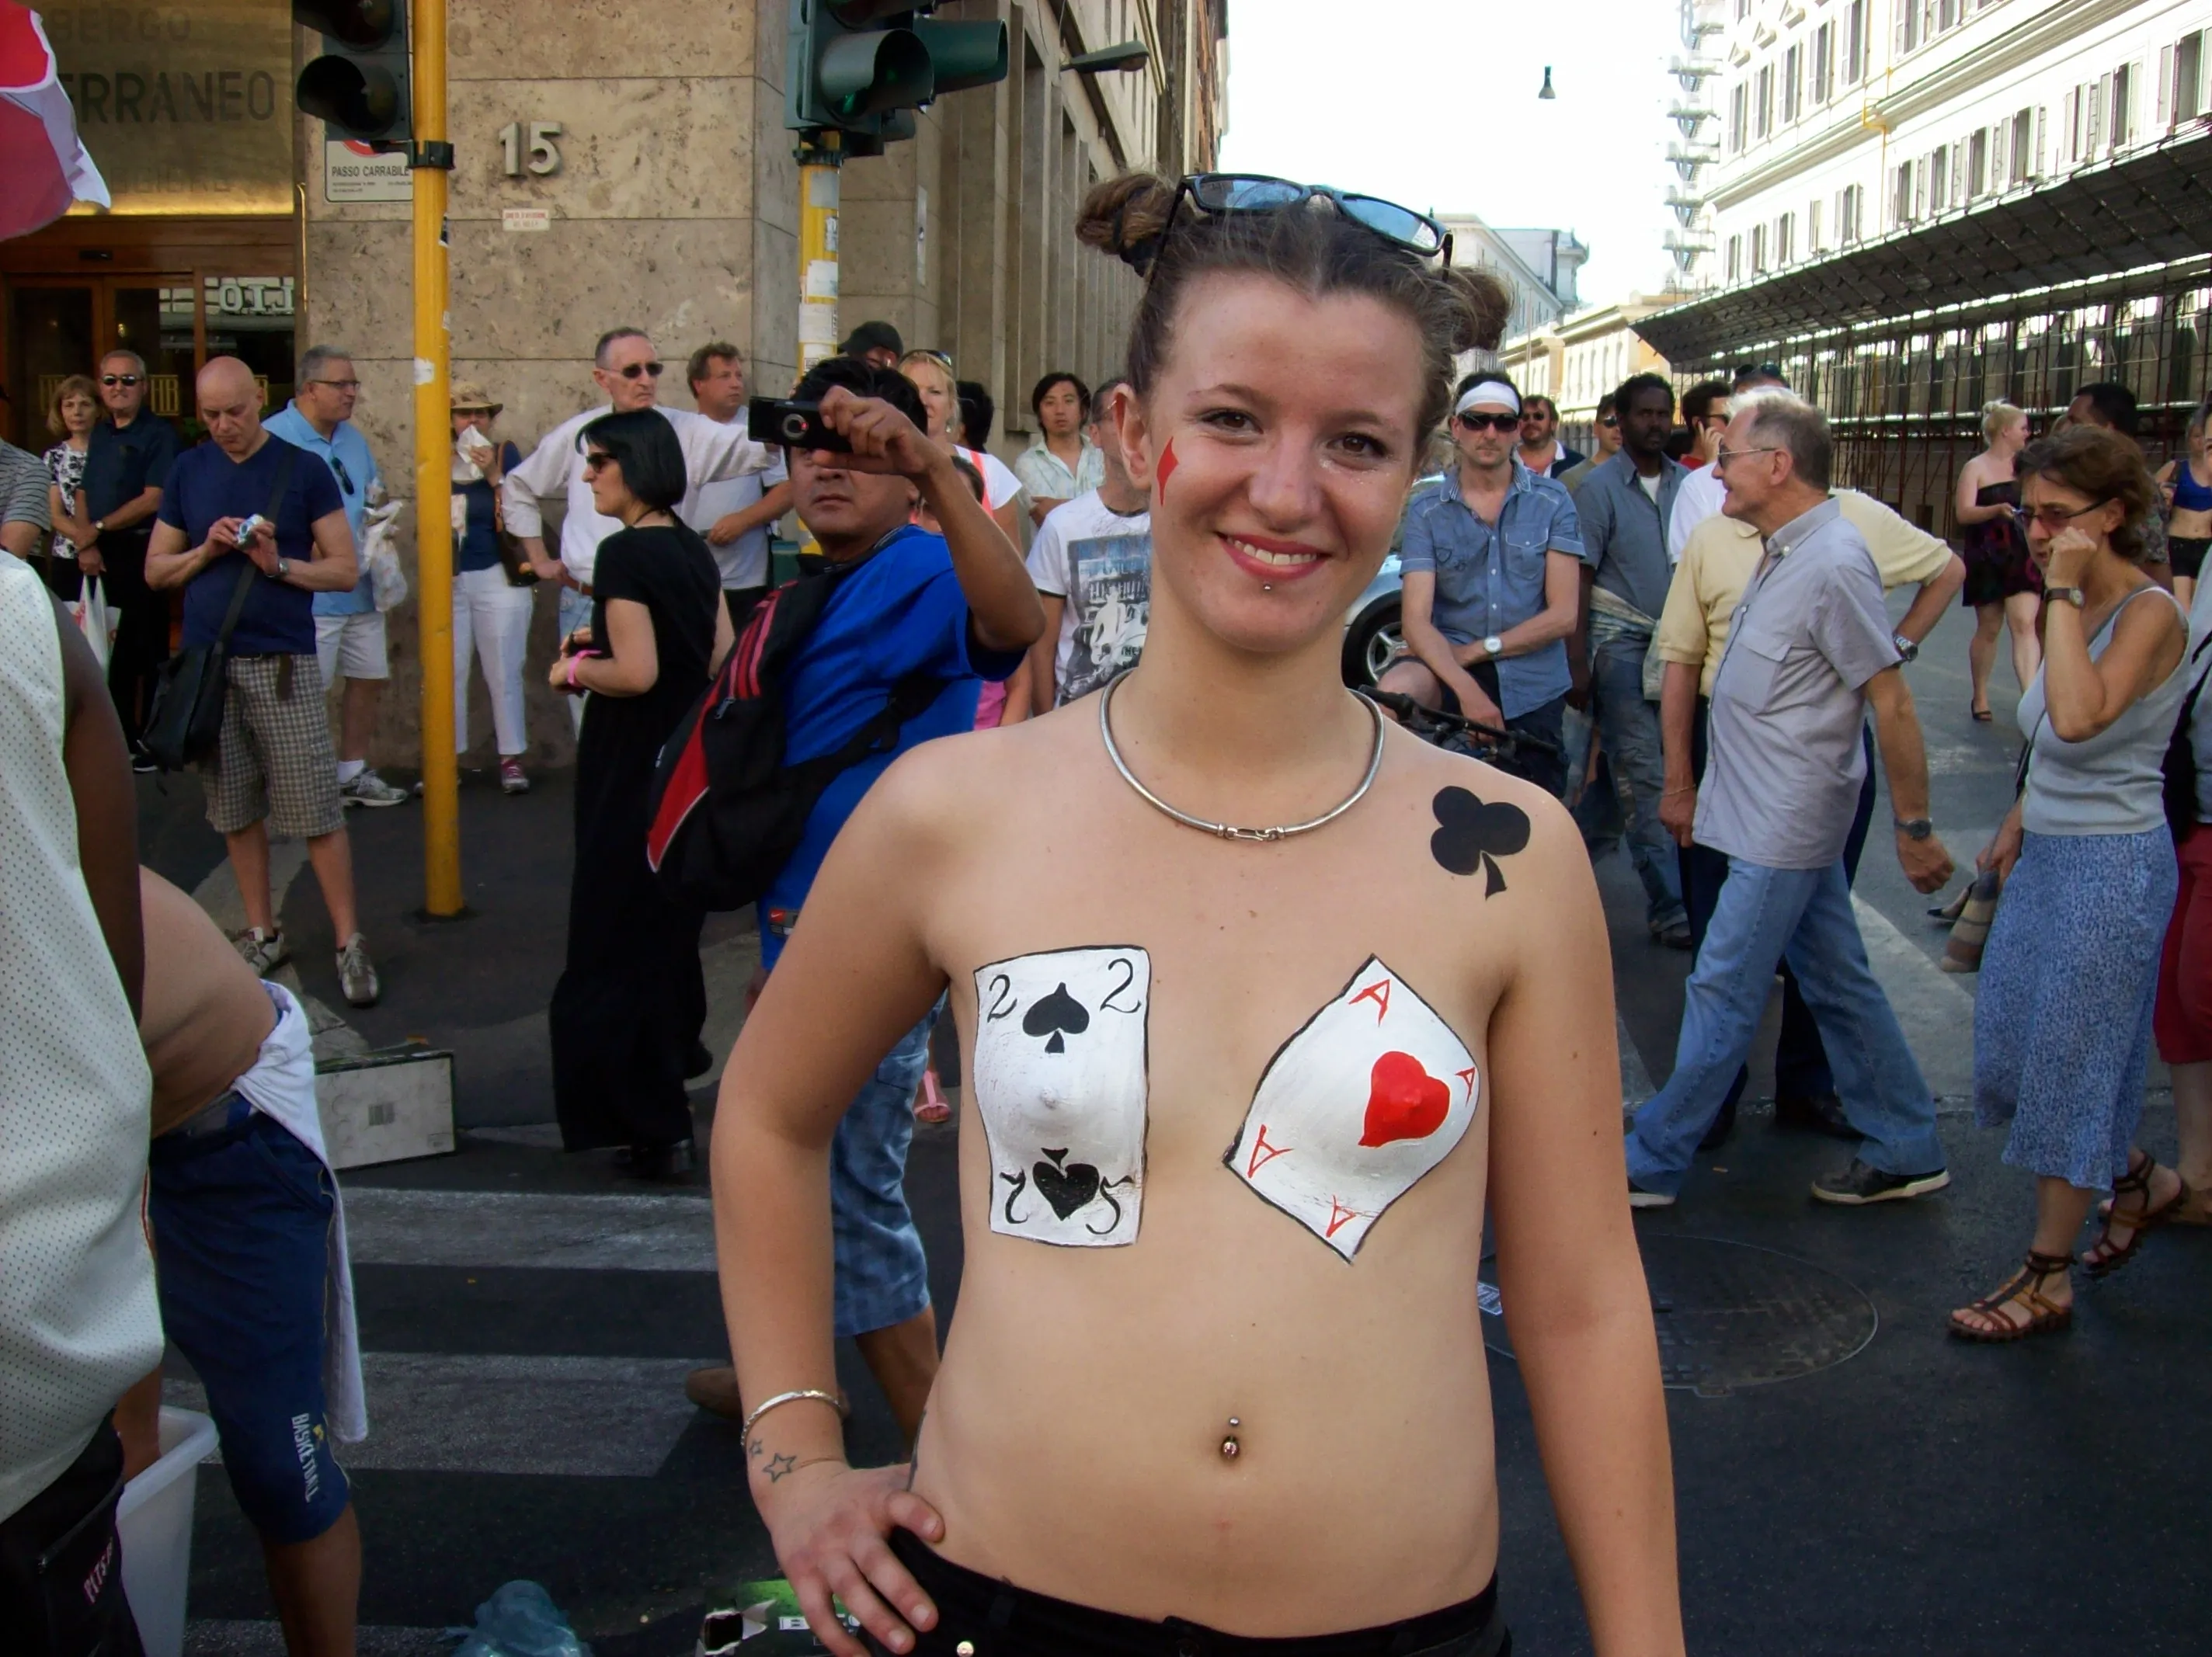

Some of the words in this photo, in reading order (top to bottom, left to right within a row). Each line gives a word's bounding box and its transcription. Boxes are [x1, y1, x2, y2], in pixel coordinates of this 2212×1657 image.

[331, 165, 360, 177] PASSO
[363, 165, 410, 176] CARRABILE
[499, 121, 562, 174] 15
[987, 974, 1018, 1023] 2
[1100, 957, 1143, 1014] 2
[1348, 979, 1390, 1027] A
[1454, 1066, 1476, 1107] A
[1247, 1124, 1295, 1179] A
[1325, 1194, 1357, 1238] A
